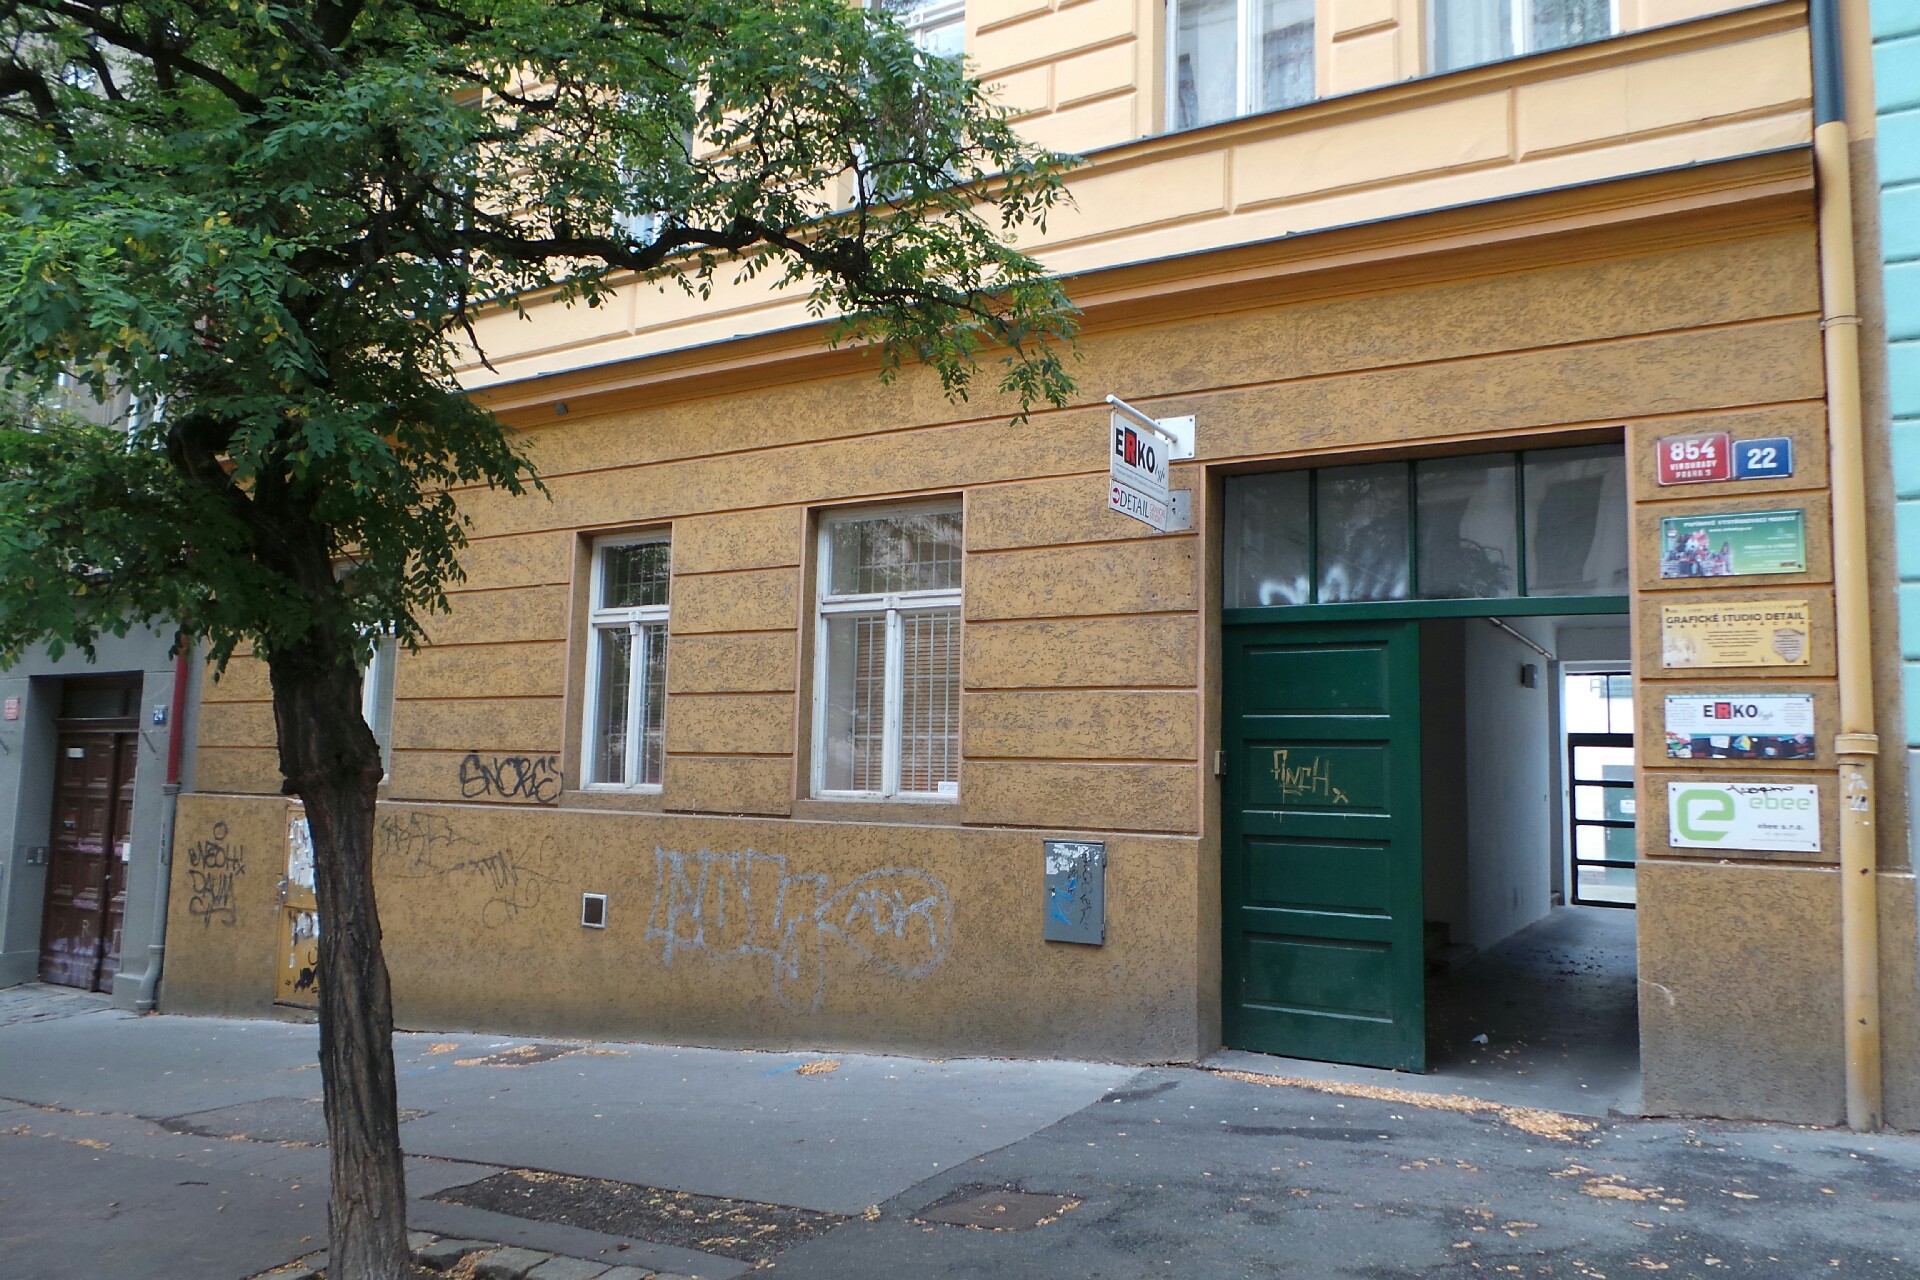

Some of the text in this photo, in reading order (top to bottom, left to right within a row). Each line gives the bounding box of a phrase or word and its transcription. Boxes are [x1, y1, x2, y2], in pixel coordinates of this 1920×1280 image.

[1116, 426, 1155, 474] ERKO
[1670, 438, 1716, 461] 854
[1747, 447, 1777, 469] 22
[1120, 490, 1149, 519] DETAIL
[1666, 612, 1805, 624] GRAFICKÉ STUDIO DETAIL
[154, 709, 164, 721] 24
[1703, 701, 1758, 720] ERKO
[1749, 793, 1811, 811] ebee
